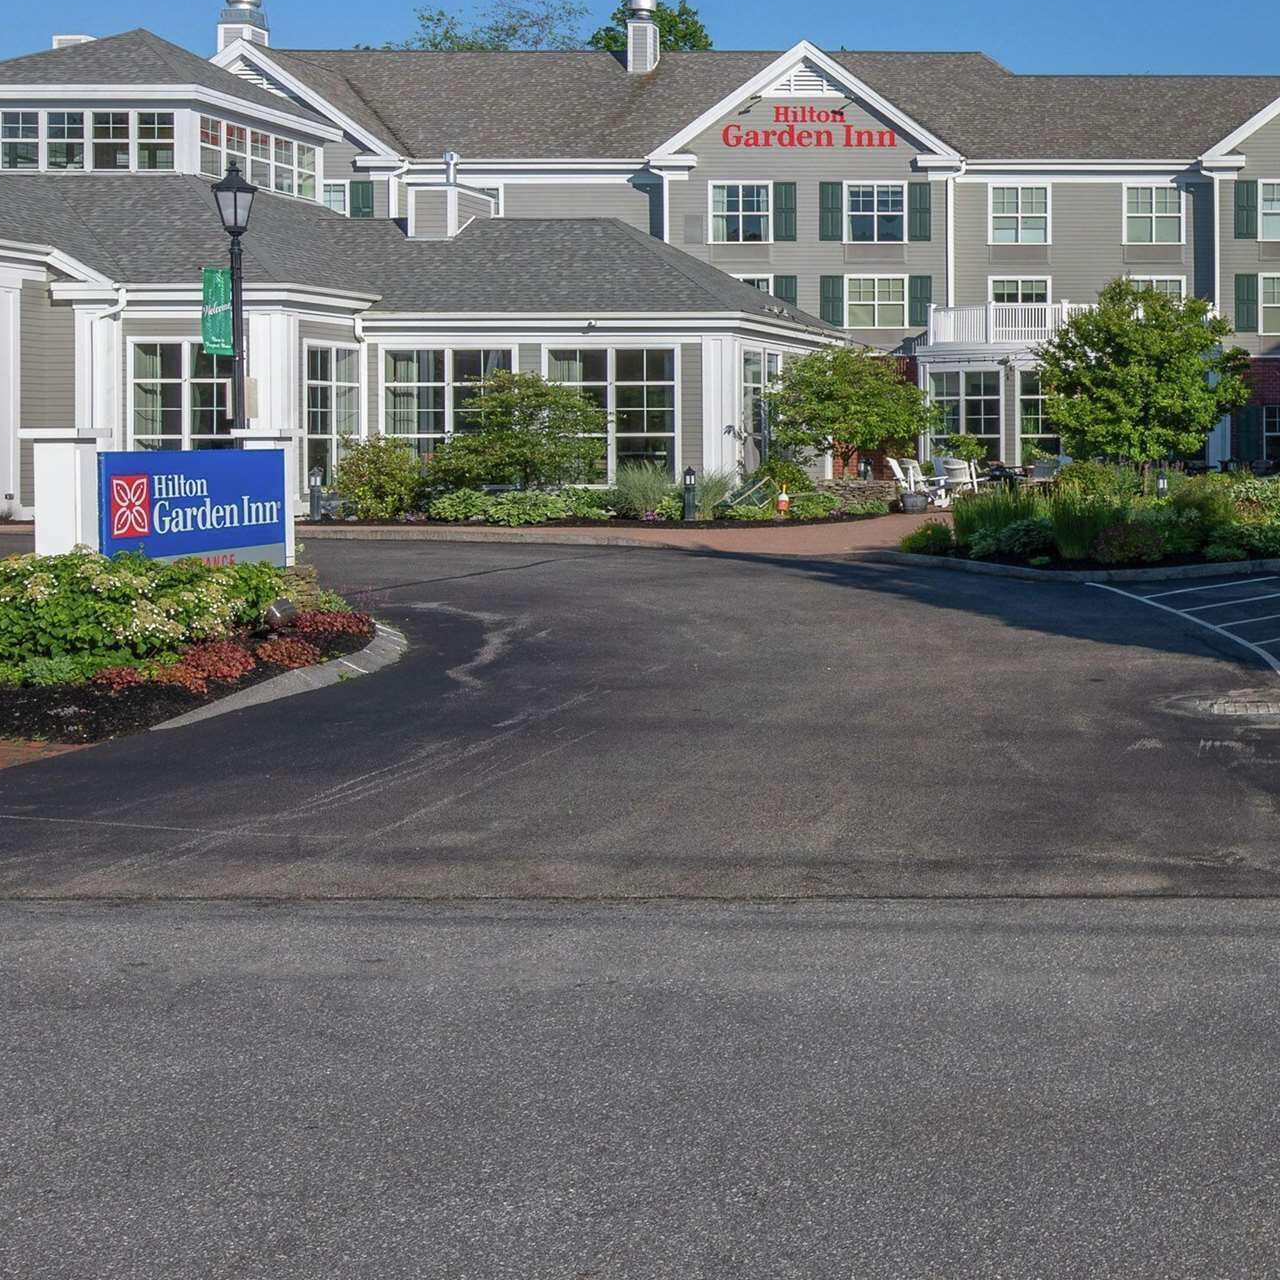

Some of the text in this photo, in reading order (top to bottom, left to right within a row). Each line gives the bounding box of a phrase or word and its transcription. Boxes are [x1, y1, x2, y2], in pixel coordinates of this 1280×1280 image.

[773, 106, 845, 123] Hilton
[722, 124, 897, 147] Garden Inn
[152, 474, 208, 499] Hilton
[153, 495, 279, 535] Garden Inn
